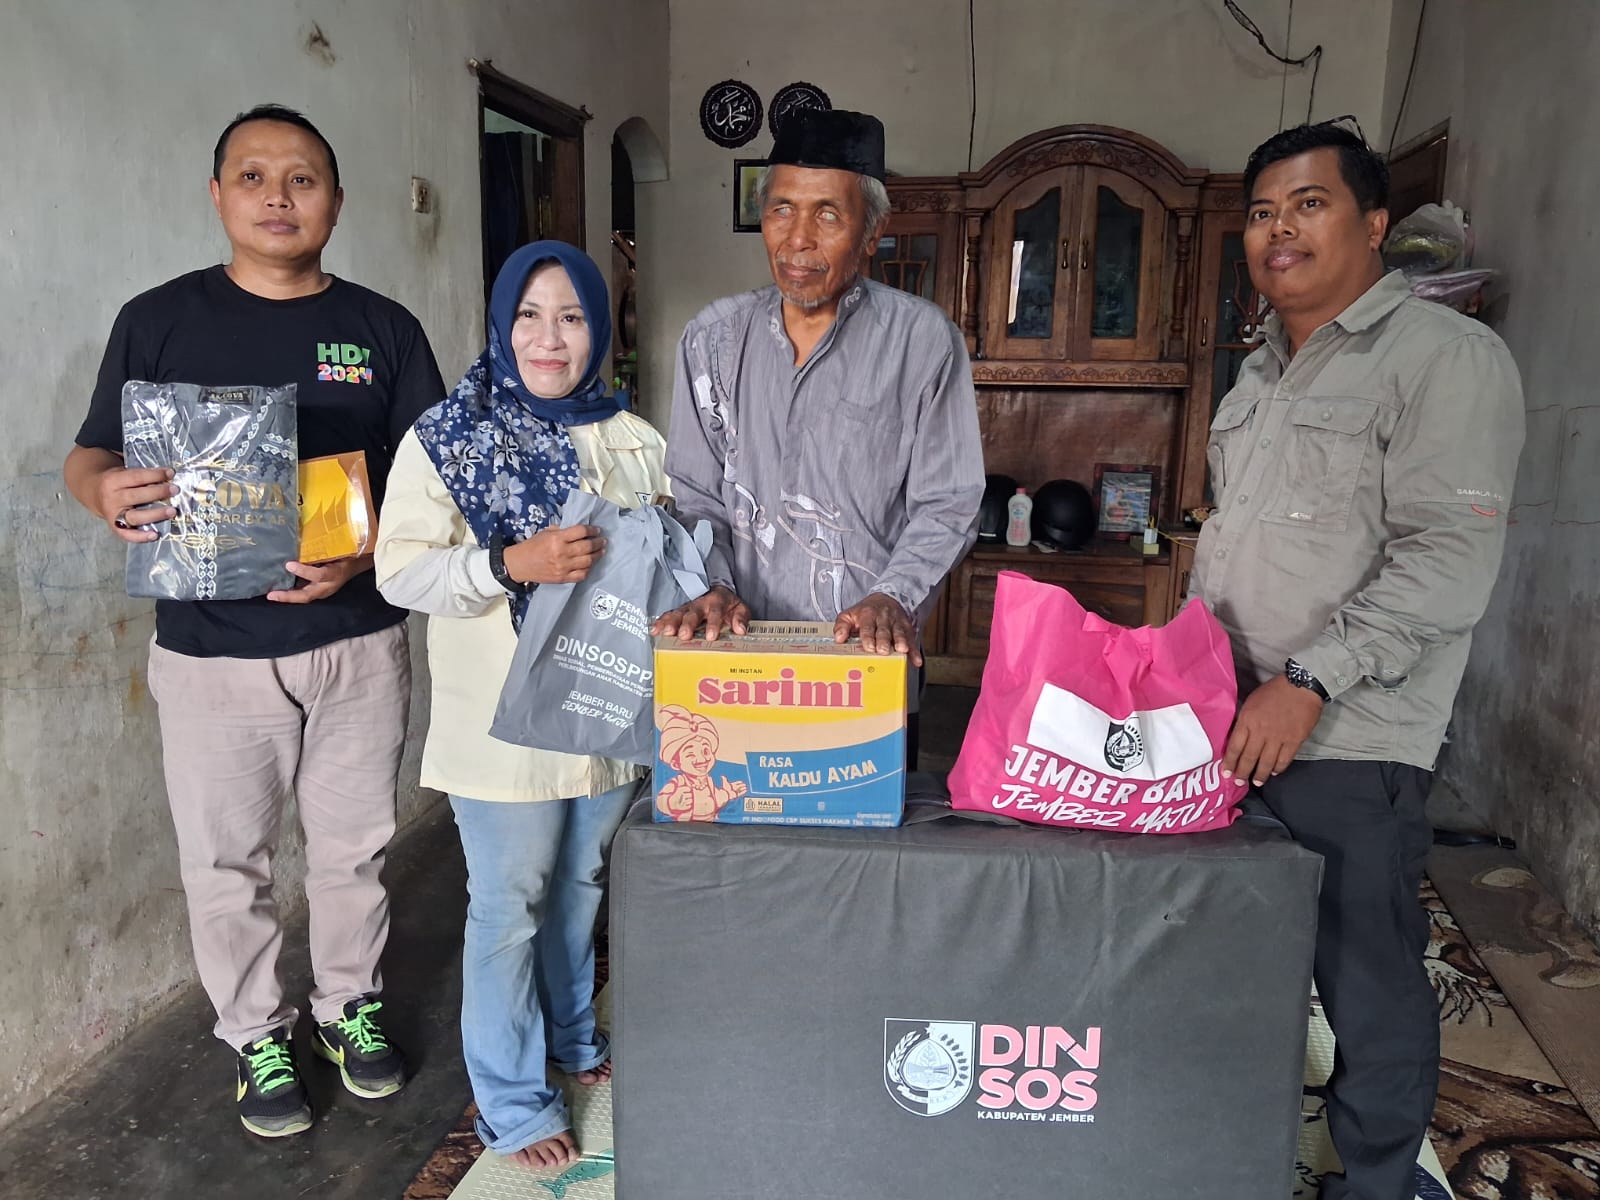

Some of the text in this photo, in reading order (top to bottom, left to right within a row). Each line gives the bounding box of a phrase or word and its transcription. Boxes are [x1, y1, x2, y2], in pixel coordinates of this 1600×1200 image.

[317, 363, 373, 385] 2024
[615, 608, 649, 634] KABUPA
[555, 634, 653, 685] DINSOSPP
[698, 668, 864, 708] sarimi
[561, 700, 603, 718] JEMBER
[605, 701, 633, 719] BARU
[759, 755, 794, 768] RASA
[768, 759, 878, 788] KALDU AYAM
[1004, 744, 1224, 806] JEMBER BARU
[991, 783, 1127, 827] JEMBER
[979, 1024, 1101, 1069] DIN
[976, 1067, 1098, 1112] SOS
[977, 1110, 1095, 1123] KABUPATEN JEMBER
